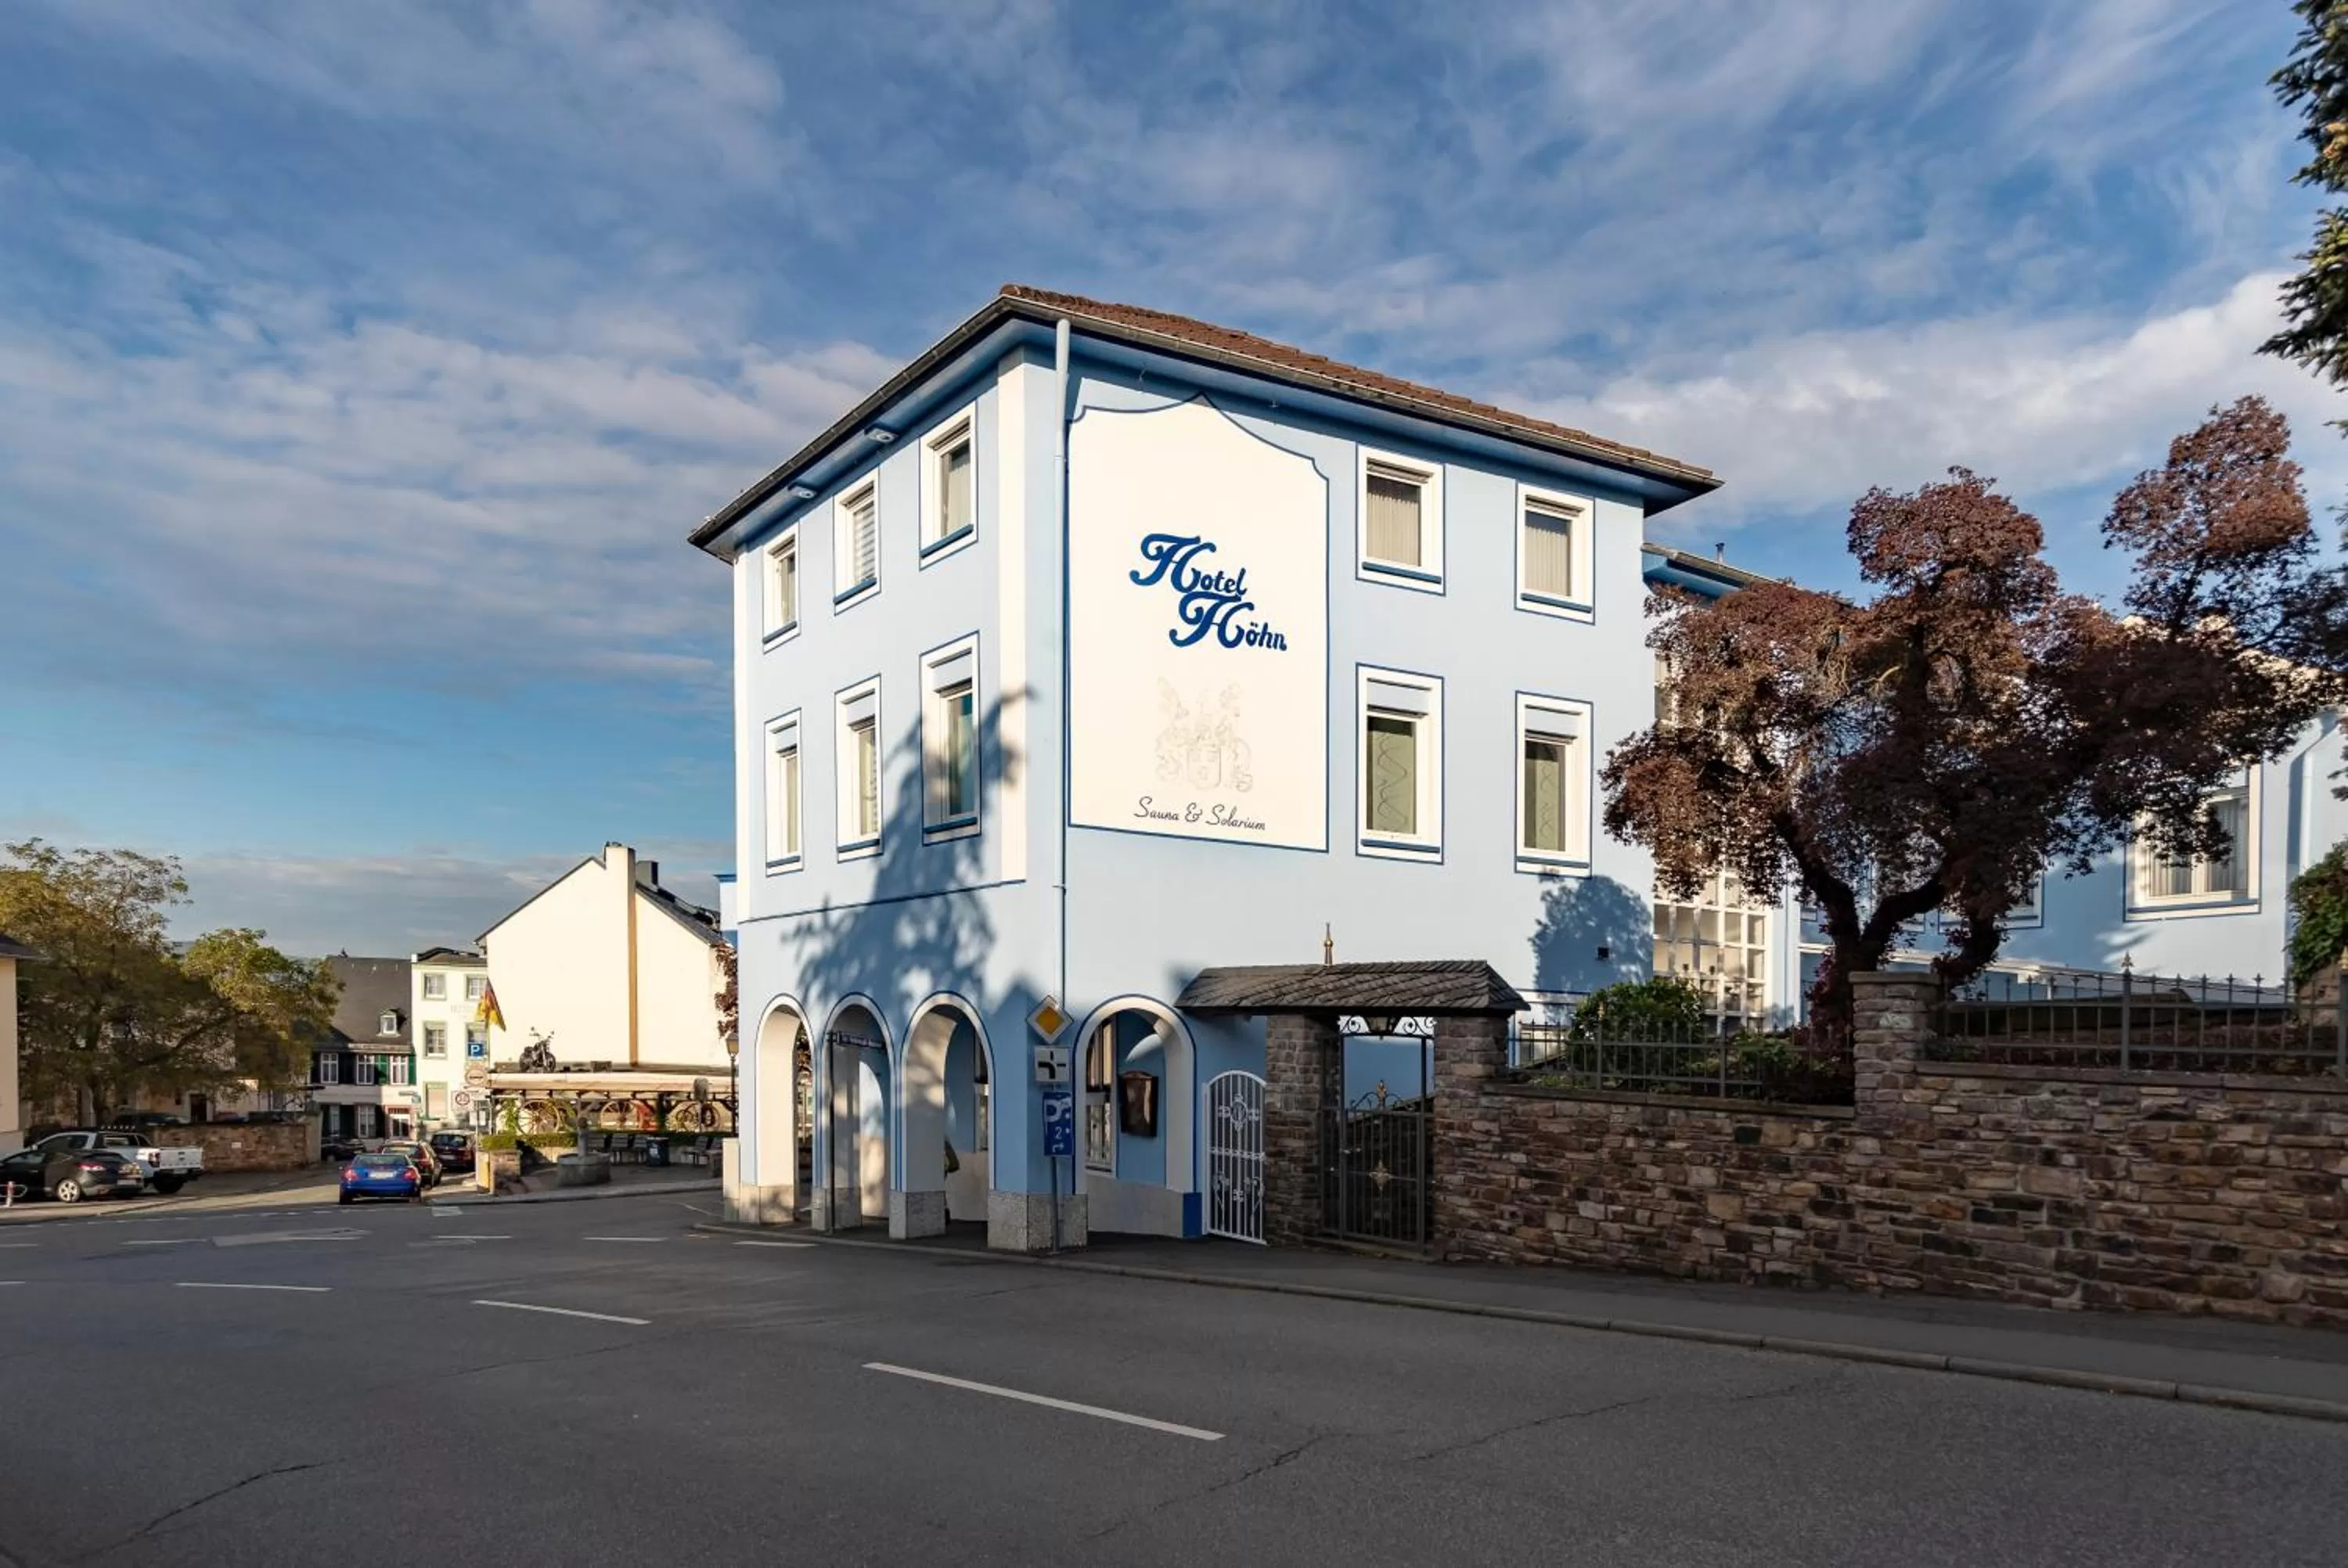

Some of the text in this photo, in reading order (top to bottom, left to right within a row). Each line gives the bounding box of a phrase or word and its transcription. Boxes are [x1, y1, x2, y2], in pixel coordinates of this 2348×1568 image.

[1129, 533, 1248, 596] Hotel
[1169, 591, 1287, 651] Höhn
[1133, 796, 1266, 830] Sauna & Solarium
[470, 1045, 481, 1056] P
